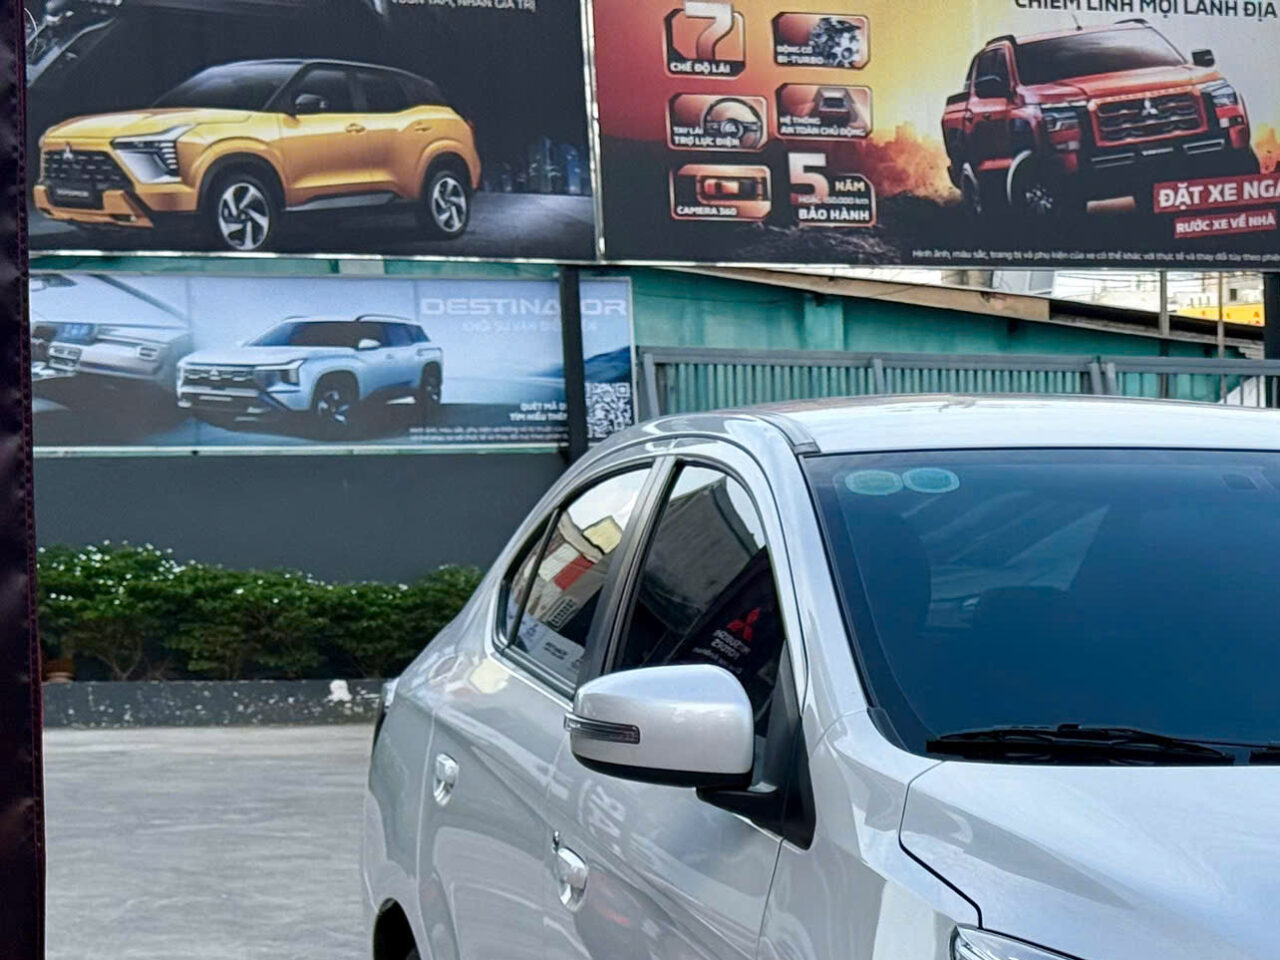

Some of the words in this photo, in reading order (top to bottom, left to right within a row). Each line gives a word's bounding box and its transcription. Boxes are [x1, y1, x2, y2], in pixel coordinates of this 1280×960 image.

[1244, 1, 1278, 21] ĐỊA
[684, 0, 734, 60] 7
[670, 61, 692, 73] CHẾ
[694, 62, 710, 74] ĐỘ
[712, 62, 731, 74] LÁI
[820, 125, 838, 135] CHỦ
[788, 152, 829, 204] 5
[834, 178, 865, 192] NĂM
[1158, 182, 1204, 210] ĐẶT
[1208, 183, 1238, 203] XE
[676, 206, 718, 216] CAMERA
[719, 207, 738, 216] 360
[798, 206, 828, 219] BẢO
[830, 207, 870, 220] HÀNH
[1212, 219, 1229, 230] XE
[1249, 212, 1276, 226] NHÀ
[421, 298, 627, 316] DESTINAOR
